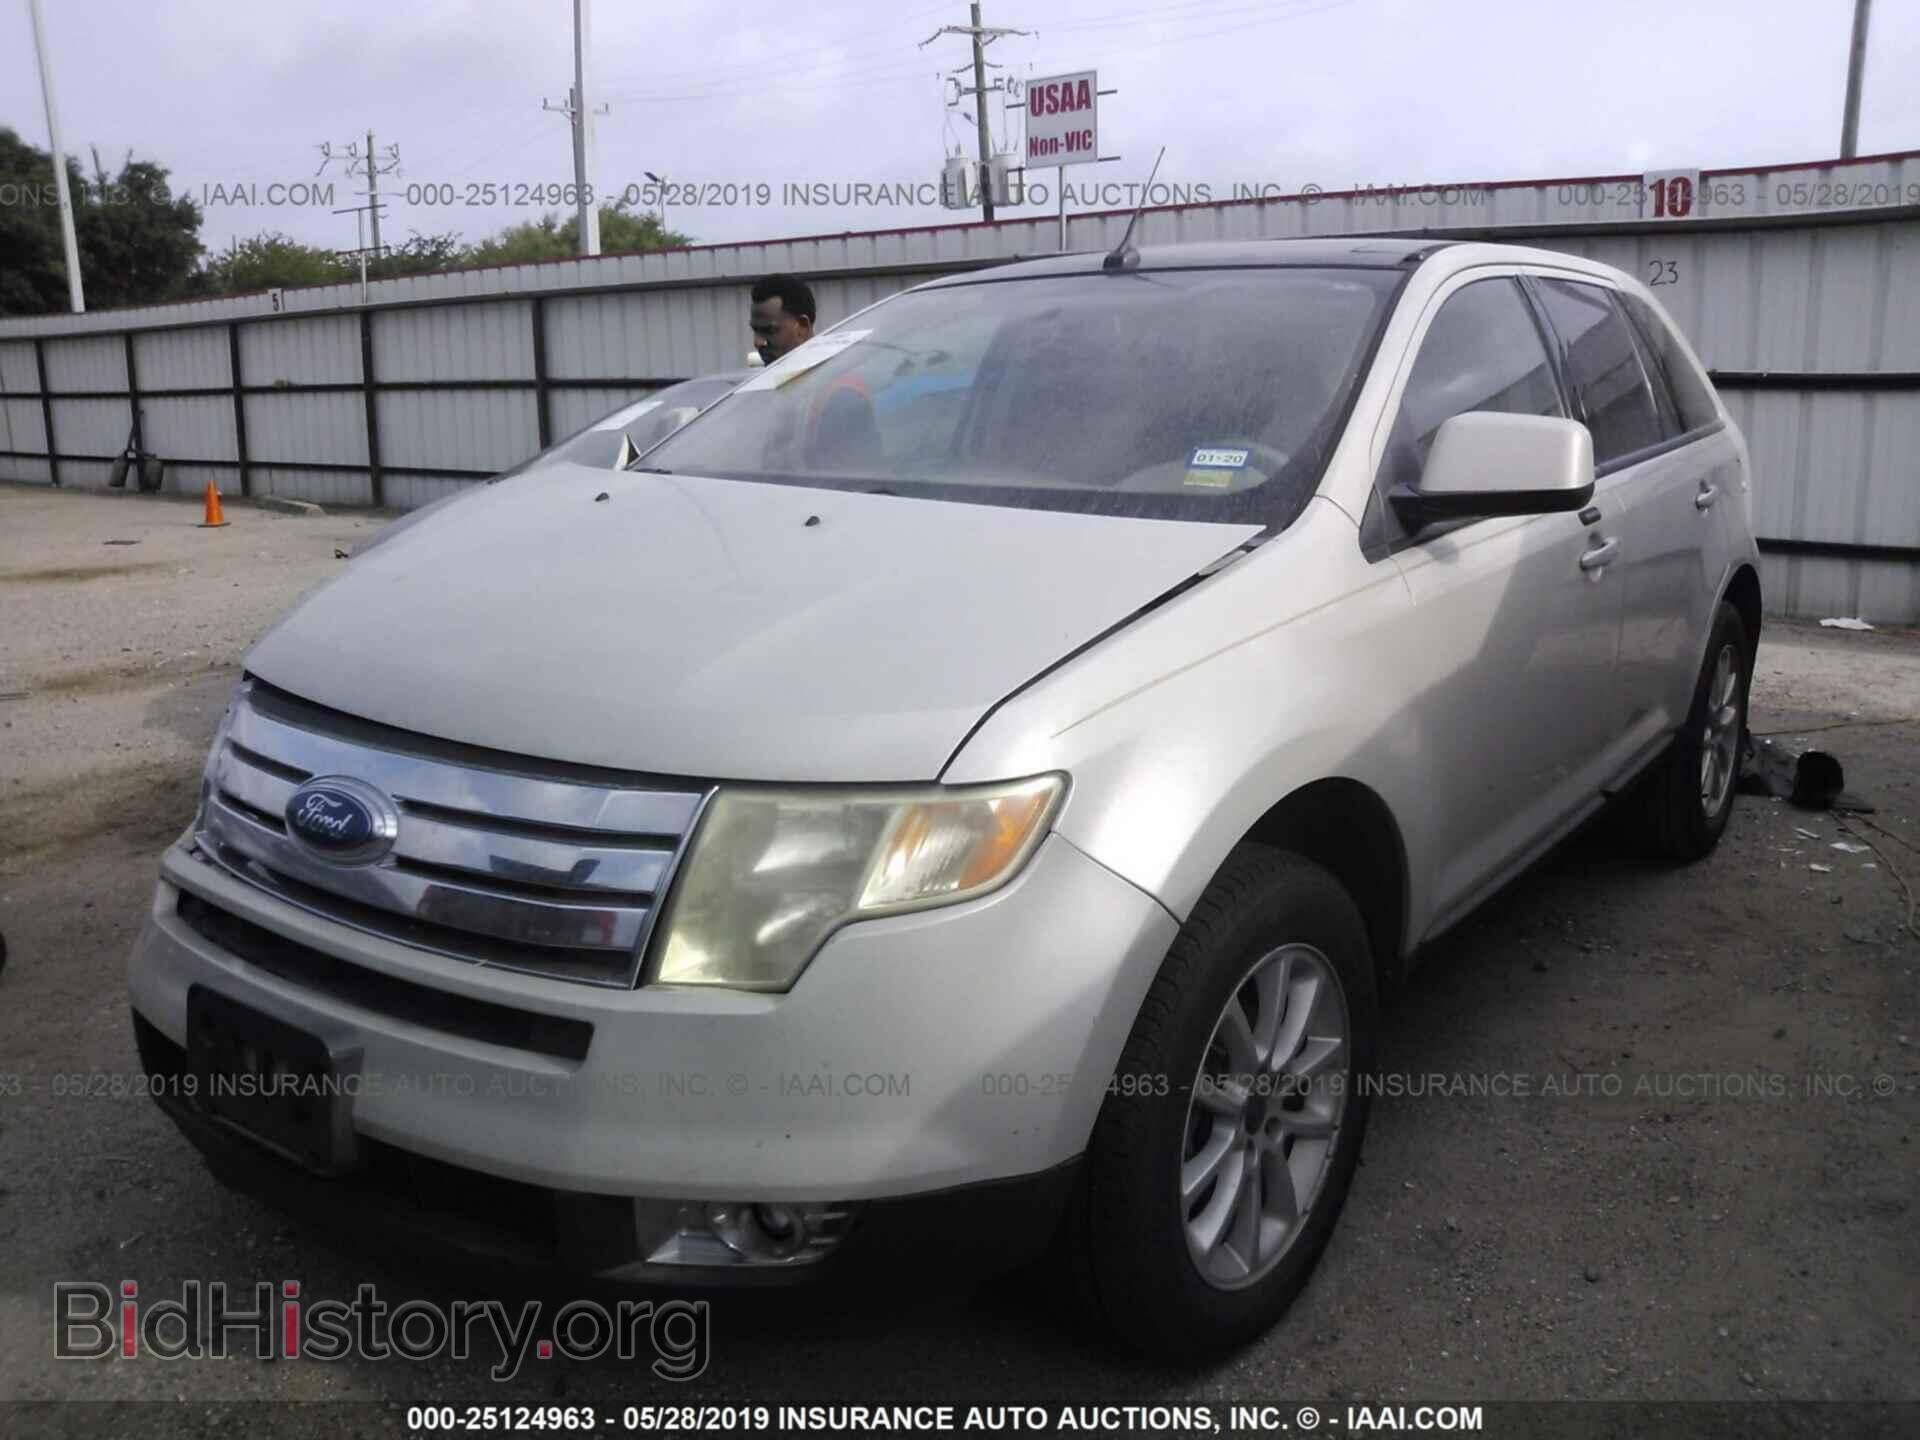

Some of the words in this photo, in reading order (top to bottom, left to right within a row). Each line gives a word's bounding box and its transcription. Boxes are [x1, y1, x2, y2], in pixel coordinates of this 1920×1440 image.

[1029, 79, 1092, 117] USAA
[1028, 129, 1093, 158] Non-VIC
[1648, 176, 1692, 217] 10
[1648, 260, 1679, 286] 23
[1196, 453, 1244, 464] 01-20
[297, 793, 353, 837] Ford
